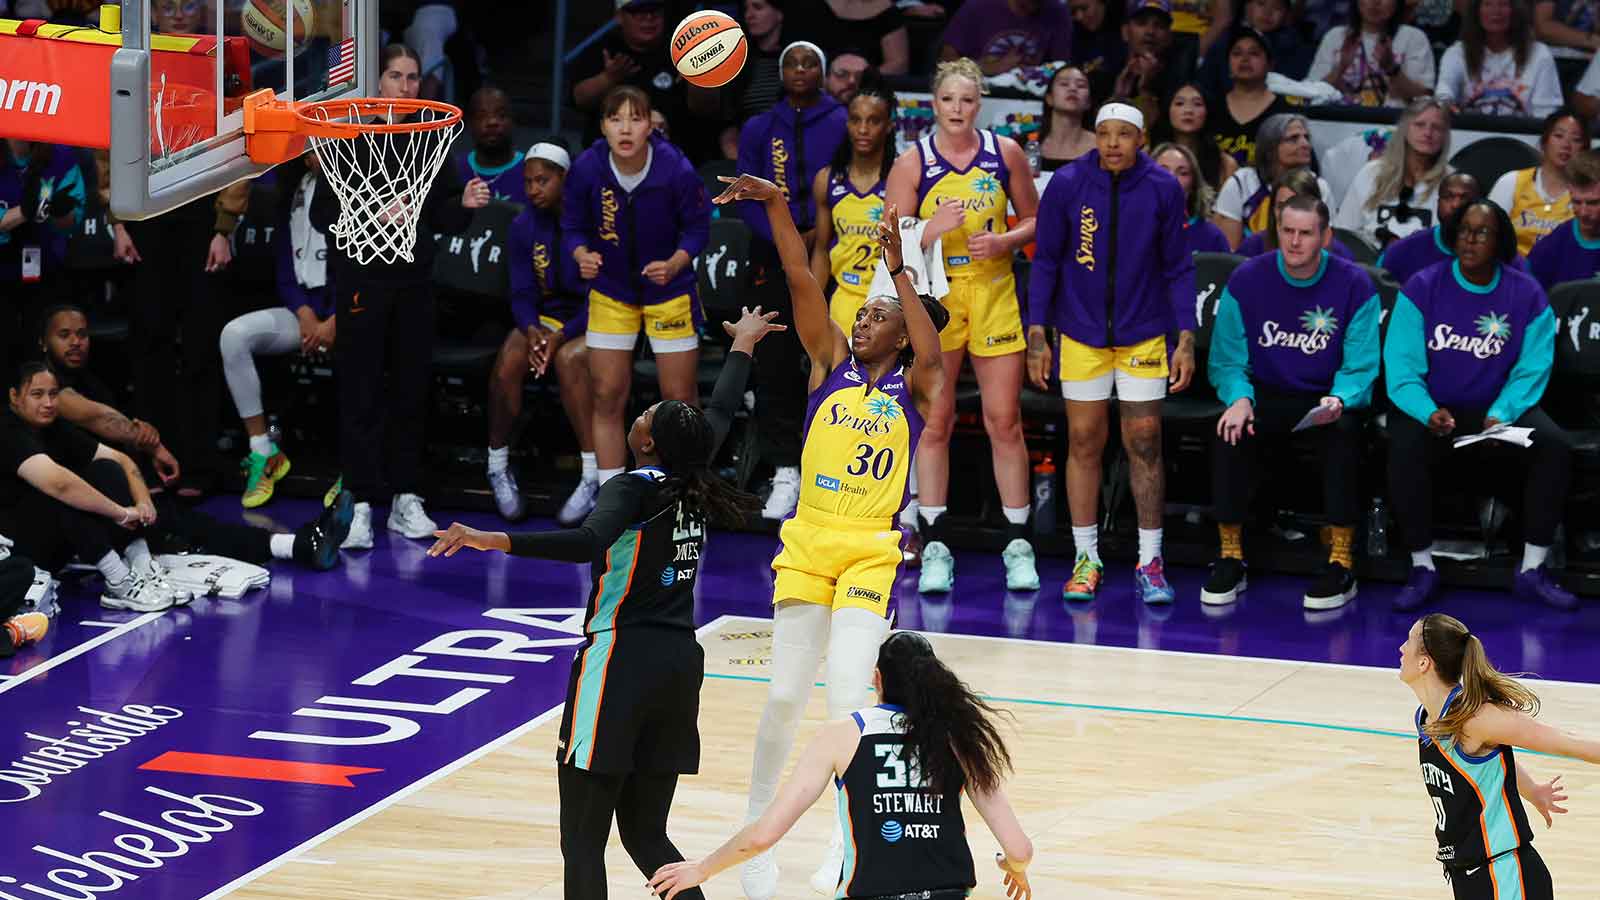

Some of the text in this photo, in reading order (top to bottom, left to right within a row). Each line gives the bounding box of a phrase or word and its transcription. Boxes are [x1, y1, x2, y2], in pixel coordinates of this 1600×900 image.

[675, 20, 719, 51] Wilson
[699, 43, 725, 64] WNBA
[837, 217, 881, 240] SPARK
[881, 382, 903, 390] Albert
[847, 443, 894, 480] 30
[818, 477, 868, 496] UCLA Health
[854, 589, 881, 602] WNBA
[248, 608, 588, 745] ULTRA
[1421, 762, 1455, 795] ERTY
[873, 793, 943, 813] STEWART
[904, 824, 940, 838] AT&T
[0, 786, 264, 900] ichelob
